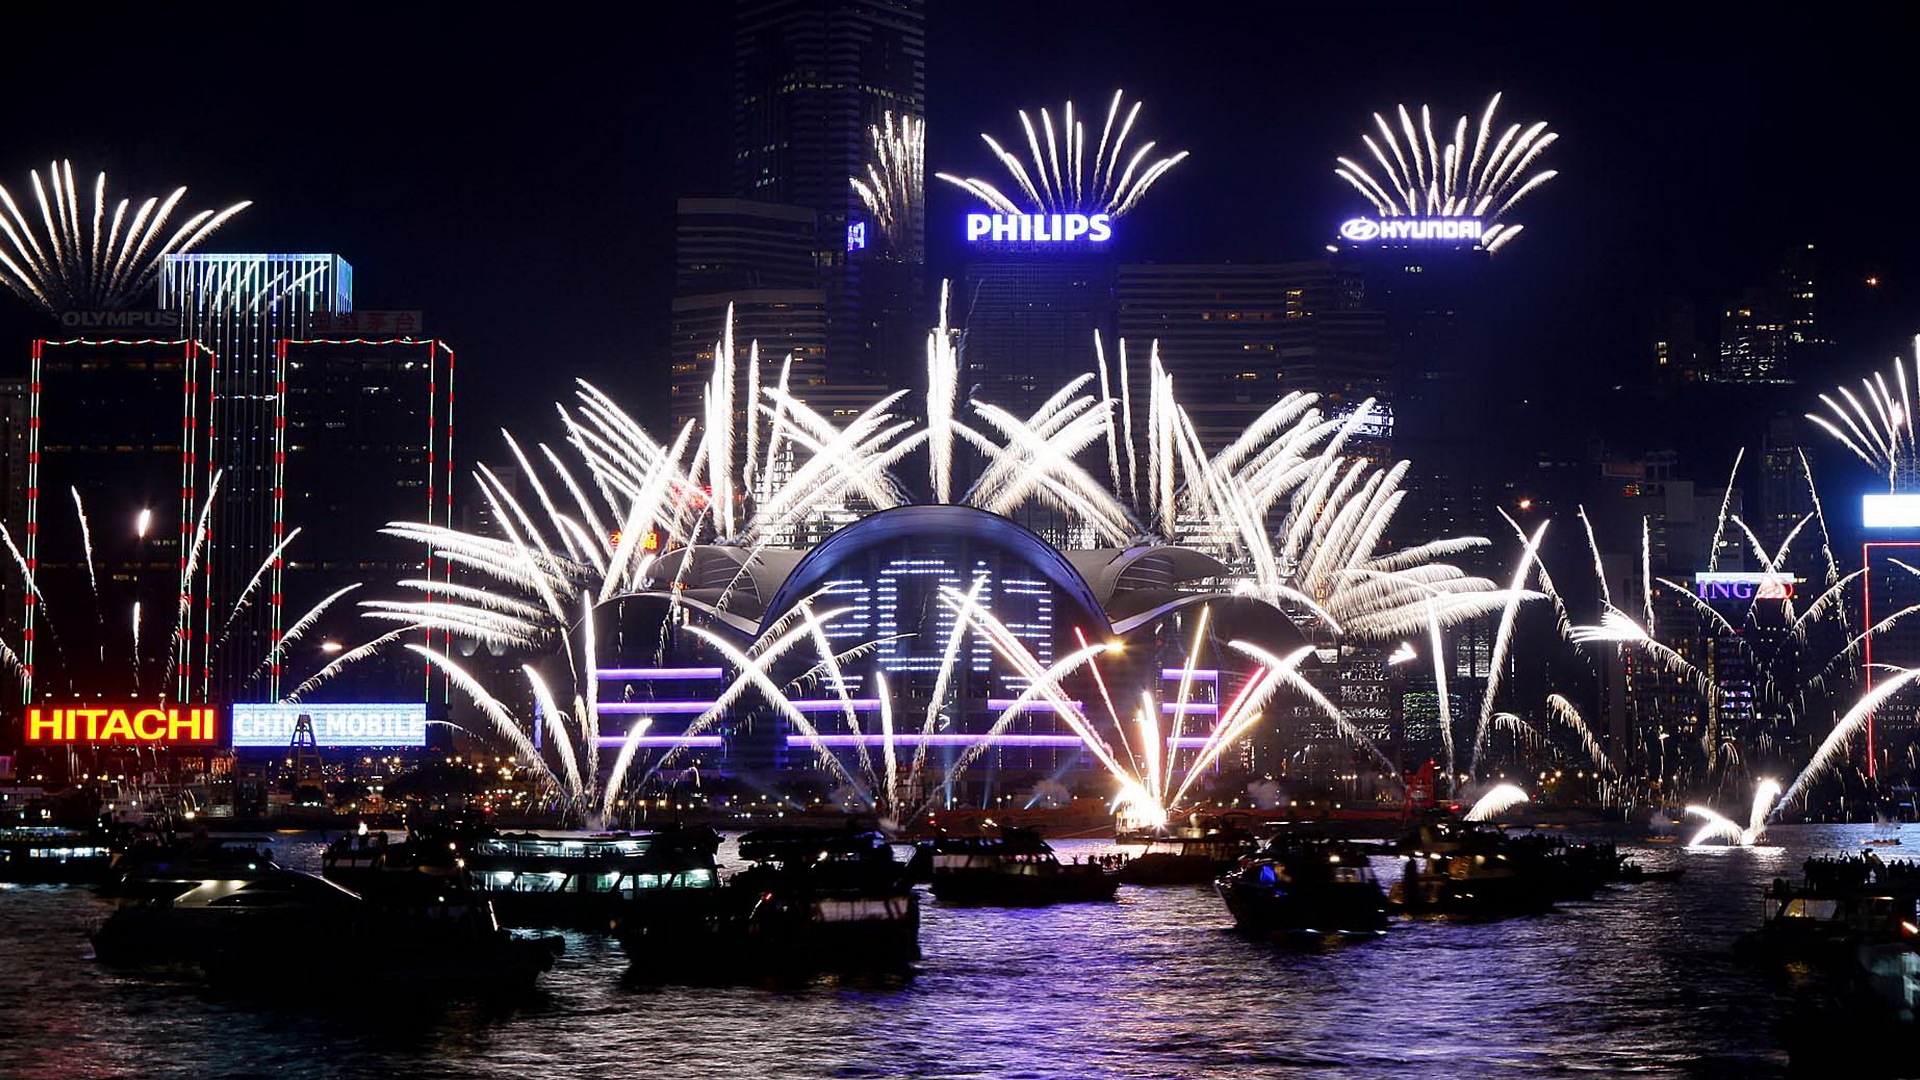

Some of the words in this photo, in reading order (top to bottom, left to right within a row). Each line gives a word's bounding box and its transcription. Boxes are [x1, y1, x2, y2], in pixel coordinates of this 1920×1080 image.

[967, 214, 1112, 241] PHILIPS
[1380, 221, 1482, 238] HYUNDAI
[61, 310, 178, 327] OLYMPUS
[1698, 580, 1752, 599] ING
[30, 709, 214, 740] HITACHI
[326, 713, 424, 736] MOBILE
